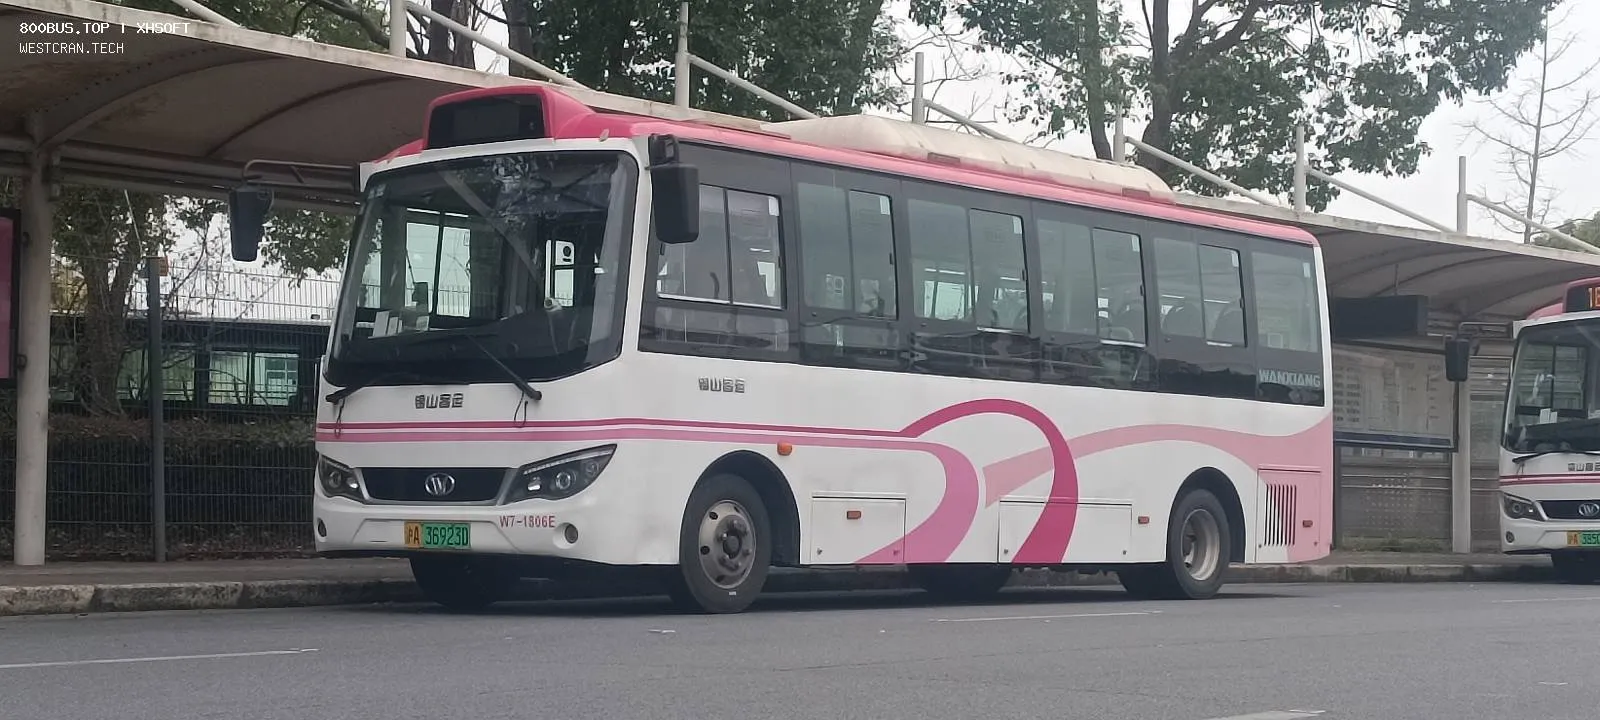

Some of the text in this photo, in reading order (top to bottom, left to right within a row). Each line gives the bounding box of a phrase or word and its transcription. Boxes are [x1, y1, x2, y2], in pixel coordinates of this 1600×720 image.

[1258, 369, 1321, 388] WANXIANG
[499, 514, 556, 528] W7-1806E
[425, 526, 469, 546] 36923D
